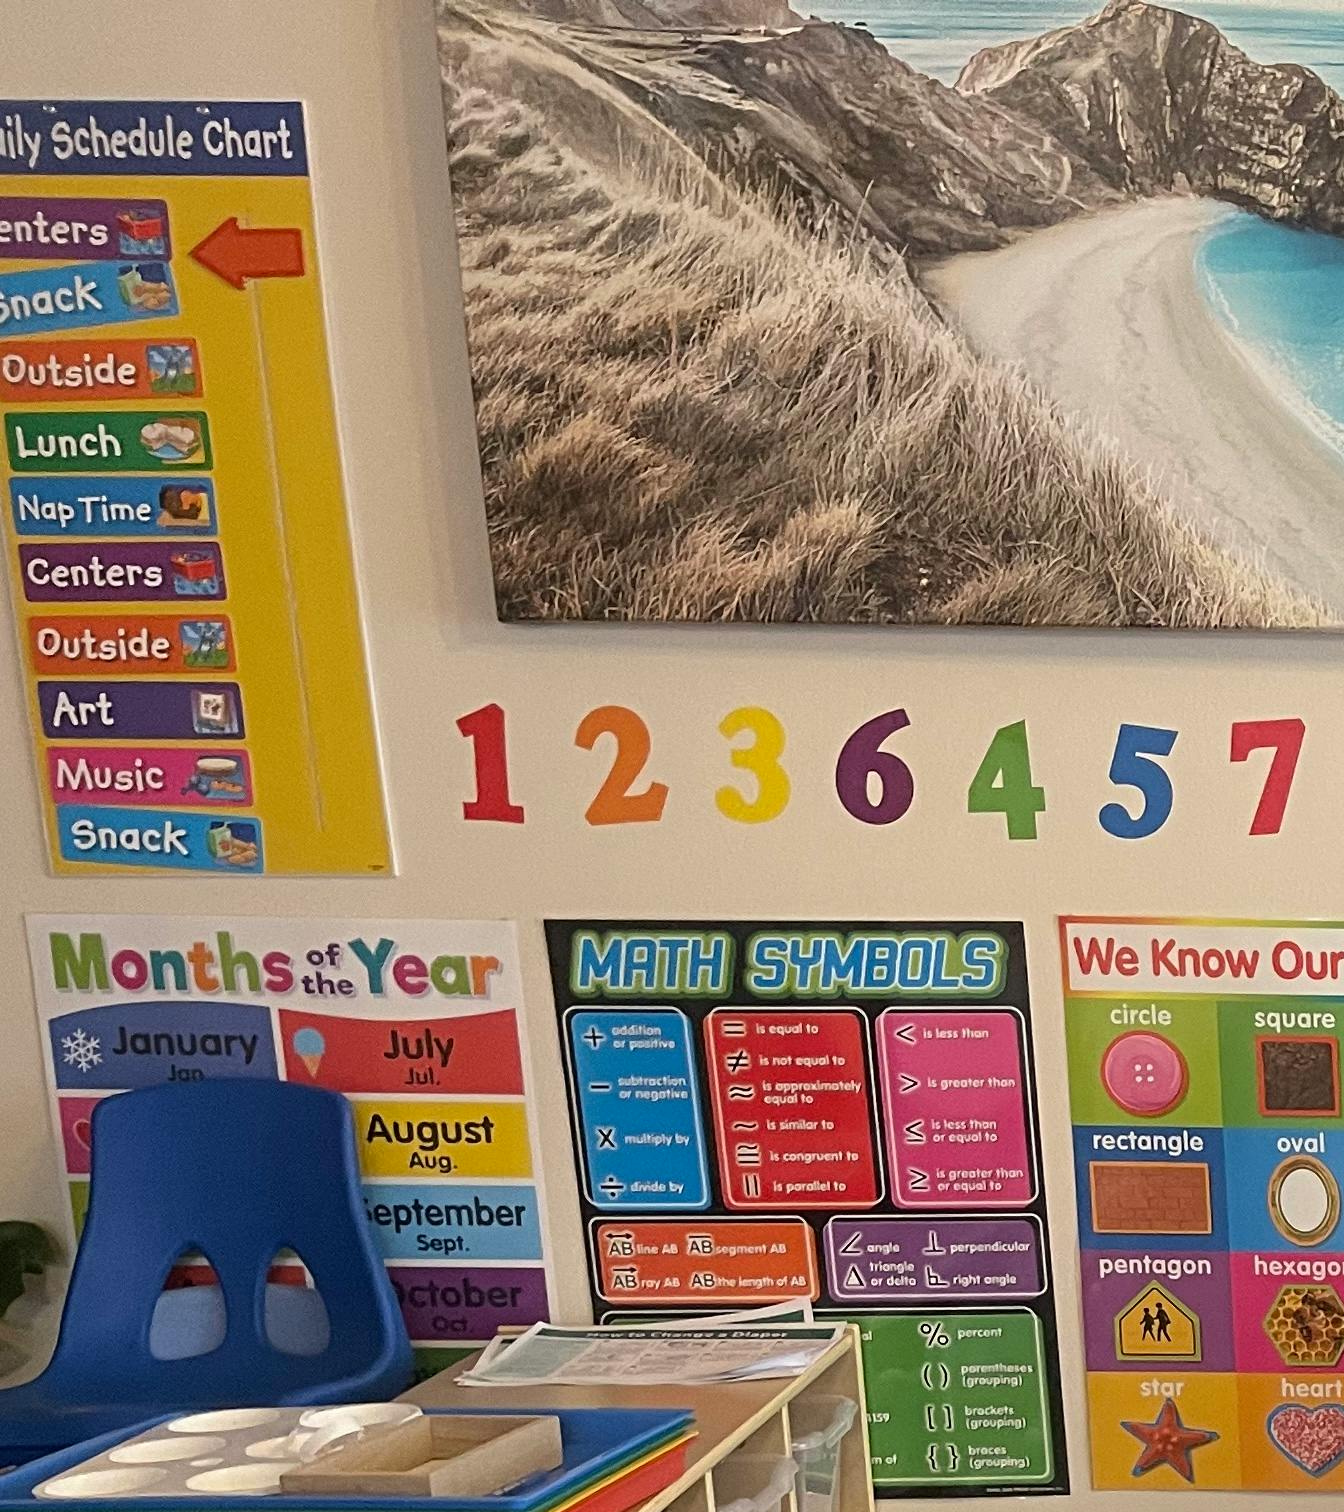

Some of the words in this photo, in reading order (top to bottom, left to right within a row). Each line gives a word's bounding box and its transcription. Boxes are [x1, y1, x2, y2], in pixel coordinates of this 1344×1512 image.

[0, 114, 40, 167] ily
[51, 117, 193, 160] Schedule
[204, 117, 293, 159] Chart
[3, 354, 136, 387] Outside
[16, 425, 121, 459] Lunch
[18, 497, 74, 527] Nap
[77, 497, 151, 521] Time
[27, 558, 162, 588] Centers
[37, 628, 169, 659] Outside
[53, 692, 114, 727] Art
[56, 760, 165, 792] Music
[456, 703, 524, 824] 1
[574, 705, 669, 826] 2
[714, 706, 792, 824] 3
[836, 708, 914, 825] 6
[968, 719, 1046, 840] 4
[1099, 723, 1179, 839] 5
[1229, 718, 1306, 836] 7
[70, 821, 189, 854] Snack
[49, 931, 294, 992] Months
[306, 943, 340, 966] of
[577, 937, 724, 990] MATH
[753, 937, 1000, 990] SYMBOLS
[1073, 937, 1140, 977] We
[1152, 939, 1259, 979] Know
[1272, 941, 1344, 980] Our
[348, 937, 500, 995] Year
[302, 972, 353, 995] the
[1110, 1005, 1172, 1025] circle
[1254, 1012, 1336, 1033] square
[756, 1023, 765, 1034] is
[769, 1023, 802, 1037] equal
[806, 1023, 818, 1034] to
[923, 1028, 932, 1038] is
[936, 1028, 958, 1038] less
[962, 1028, 988, 1038] than
[113, 1026, 258, 1064] January
[384, 1028, 454, 1067] July
[760, 1055, 768, 1065] is
[773, 1056, 791, 1065] not
[796, 1055, 829, 1068] equal
[832, 1055, 845, 1066] to
[404, 1068, 440, 1085] Jul.
[762, 1081, 771, 1091] is
[776, 1080, 861, 1093] approximately
[928, 1077, 937, 1087] is
[941, 1078, 984, 1090] greater
[988, 1077, 1015, 1088] than
[764, 1094, 797, 1106] equal
[801, 1094, 813, 1103] to
[367, 1114, 494, 1150] August
[931, 1120, 940, 1129] is
[944, 1120, 966, 1130] less
[970, 1120, 996, 1129] than
[1093, 1131, 1203, 1156] rectangle
[1277, 1132, 1325, 1153] oval
[409, 1152, 458, 1173] Aug.
[363, 1196, 526, 1233] eptember
[417, 1234, 470, 1255] Sept.
[867, 1242, 900, 1254] angle
[950, 1242, 1030, 1255] perpendicular
[870, 1262, 914, 1273] triangle
[1099, 1257, 1211, 1279] pentagon
[871, 1277, 883, 1286] or
[887, 1275, 917, 1286] delta
[953, 1275, 980, 1287] right
[984, 1274, 1016, 1287] angle
[958, 1328, 1002, 1340] percent
[961, 1364, 1033, 1374] parentheses
[962, 1375, 1022, 1387] (grouping)
[1140, 1379, 1184, 1397] star
[1282, 1378, 1343, 1398] heart
[965, 1406, 1014, 1415] brackets
[966, 1417, 1026, 1429] (grouping)
[968, 1446, 1006, 1455] braces
[969, 1457, 1030, 1469] (grouping)
